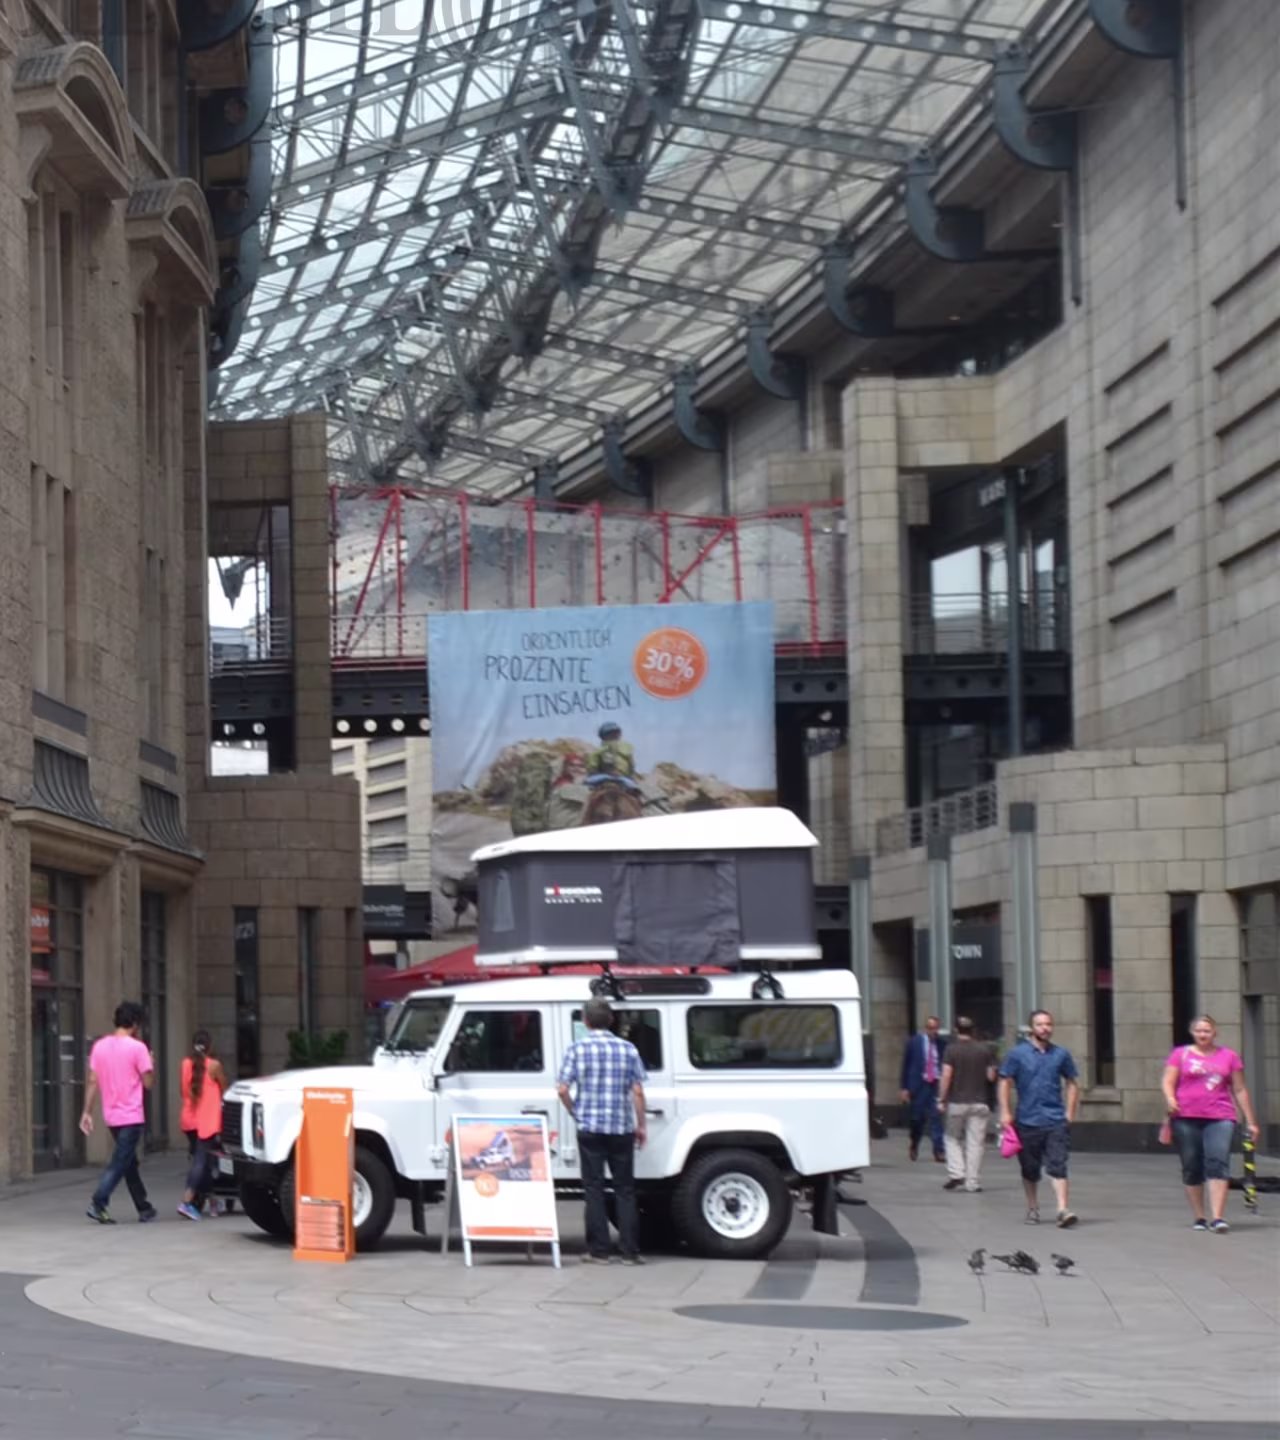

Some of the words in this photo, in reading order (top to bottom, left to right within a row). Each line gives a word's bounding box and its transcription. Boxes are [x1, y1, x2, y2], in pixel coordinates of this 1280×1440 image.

[521, 629, 611, 650] ORDENTLICH
[485, 656, 592, 683] PROZENTE
[523, 685, 632, 719] EINSACKEN
